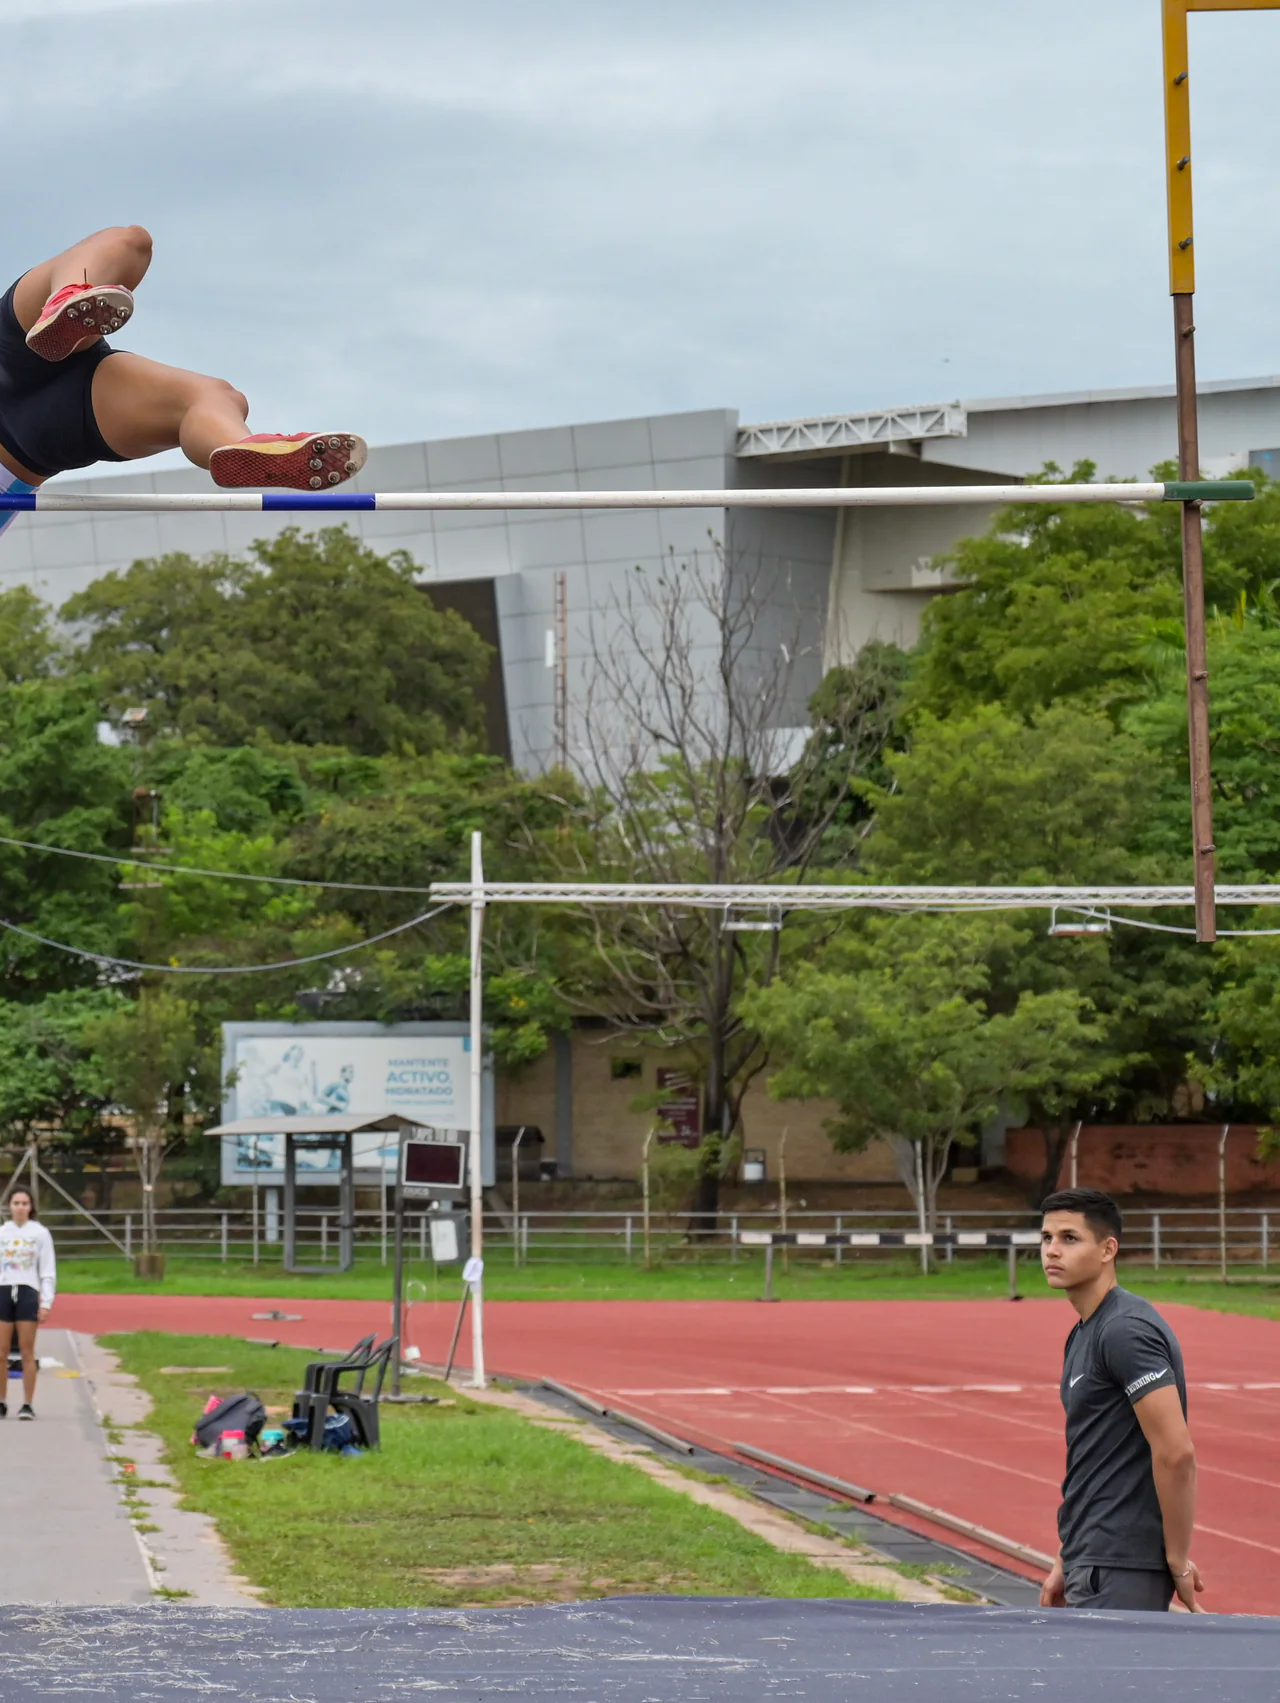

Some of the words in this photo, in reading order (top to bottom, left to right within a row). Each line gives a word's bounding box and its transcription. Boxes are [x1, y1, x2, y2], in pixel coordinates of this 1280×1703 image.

[387, 1058, 449, 1067] MANTENTE
[385, 1086, 453, 1096] HIDRATADO
[1127, 1372, 1156, 1394] RUNNING
